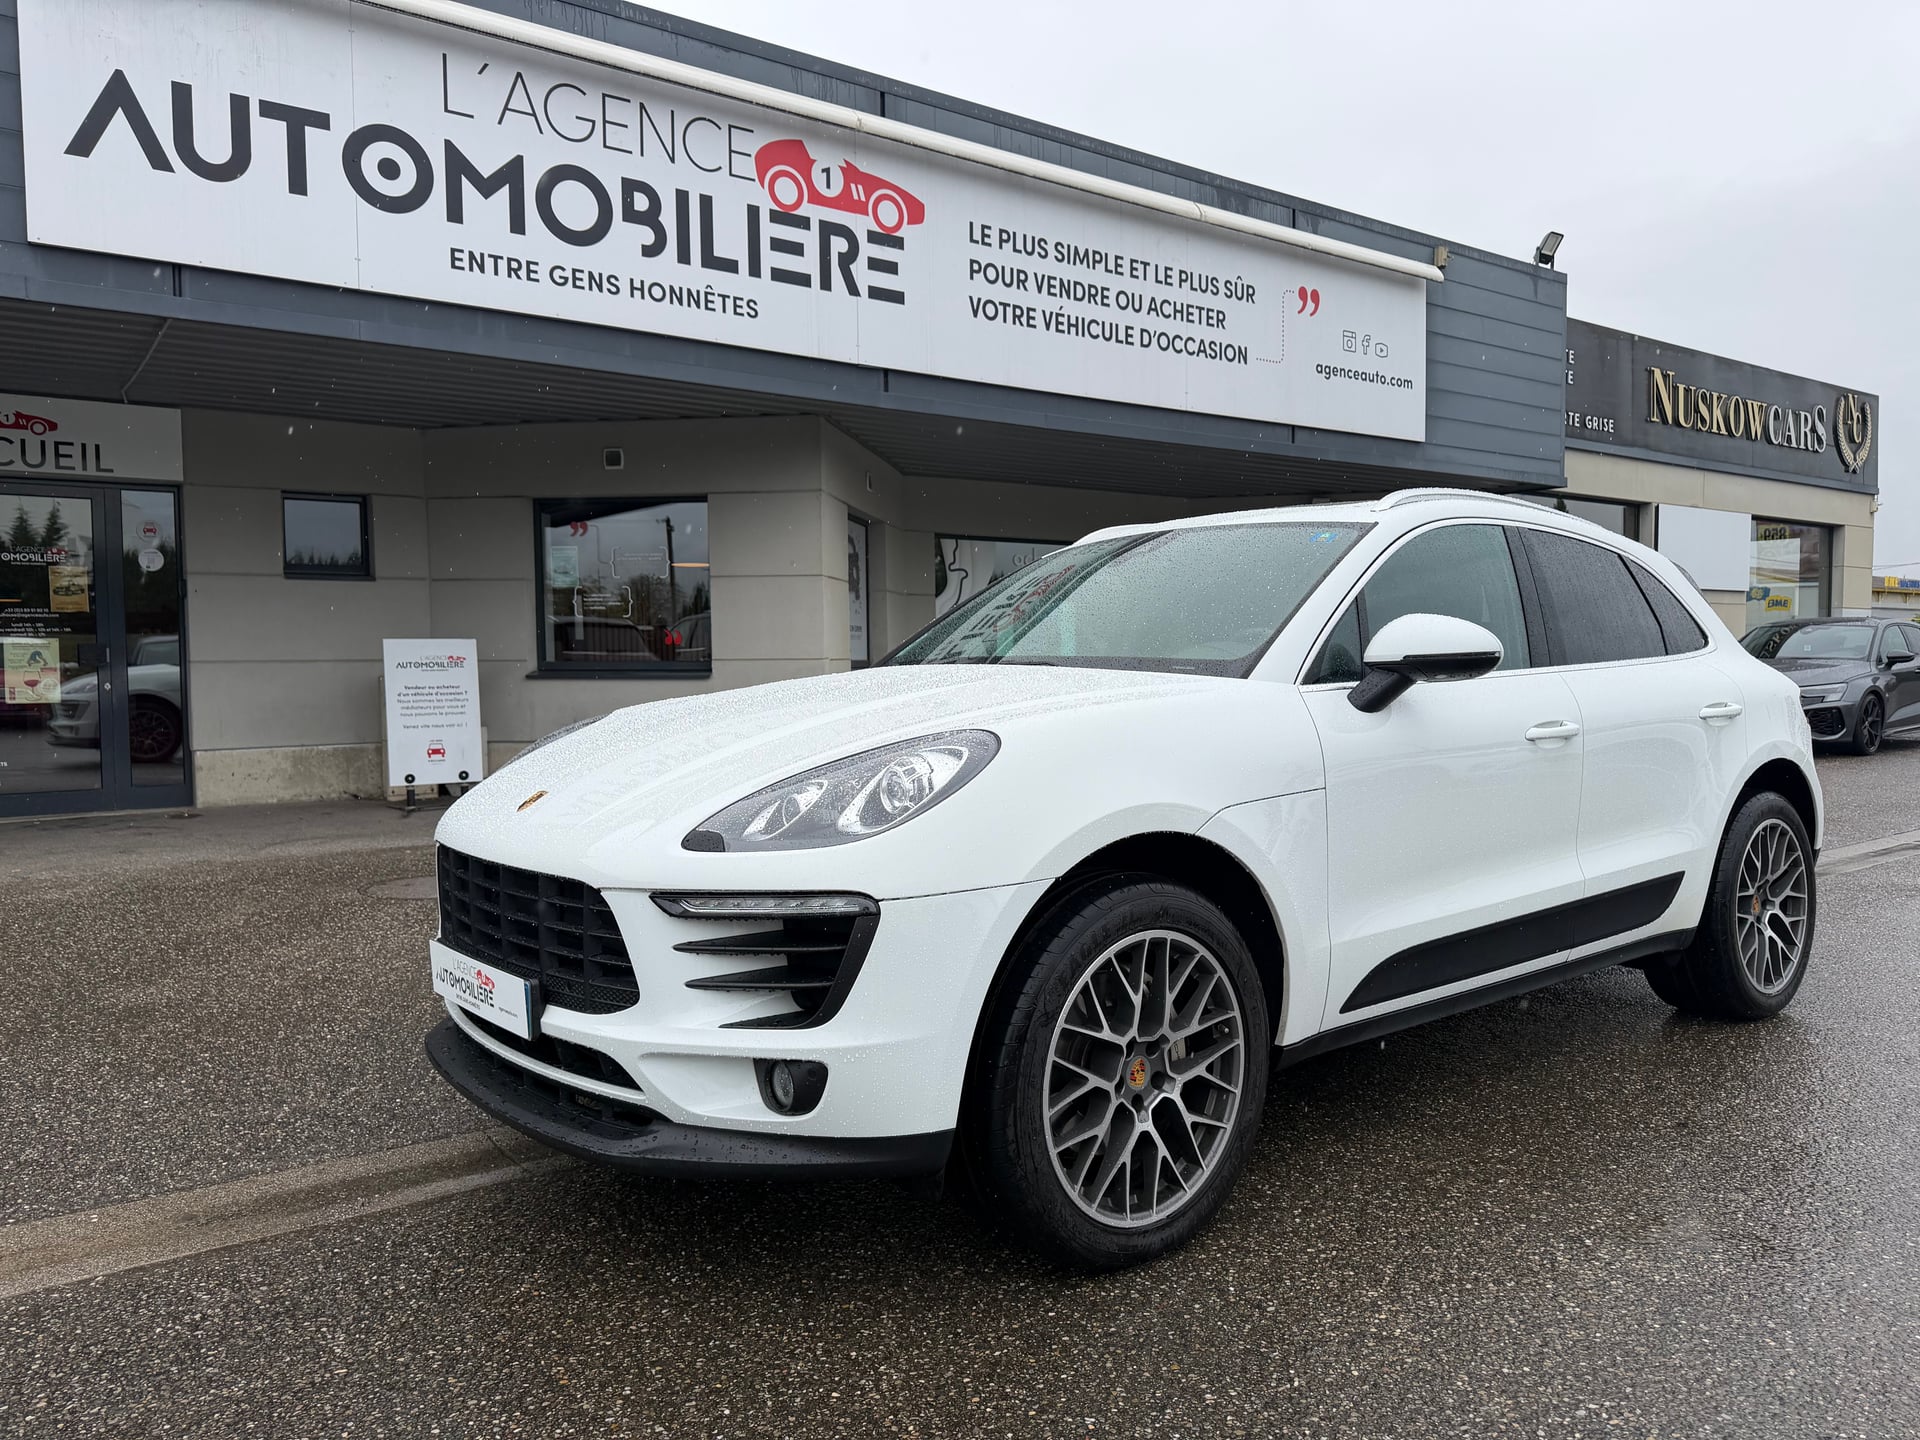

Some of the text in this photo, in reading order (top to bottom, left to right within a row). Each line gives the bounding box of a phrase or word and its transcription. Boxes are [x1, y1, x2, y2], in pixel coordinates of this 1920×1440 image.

[820, 166, 833, 190] 1
[449, 247, 760, 319] ENTRE GENS HONNÊTES
[968, 220, 1256, 305] LE PLUS SIMPLE ET LE PLUS SÛR
[969, 258, 1227, 330] POUR VENDRE OU ACHETER
[968, 295, 1248, 366] VOTRE VÉHICULE D'OCCASION
[1315, 363, 1414, 390] agenceauto.com
[1585, 414, 1616, 434] GRISE
